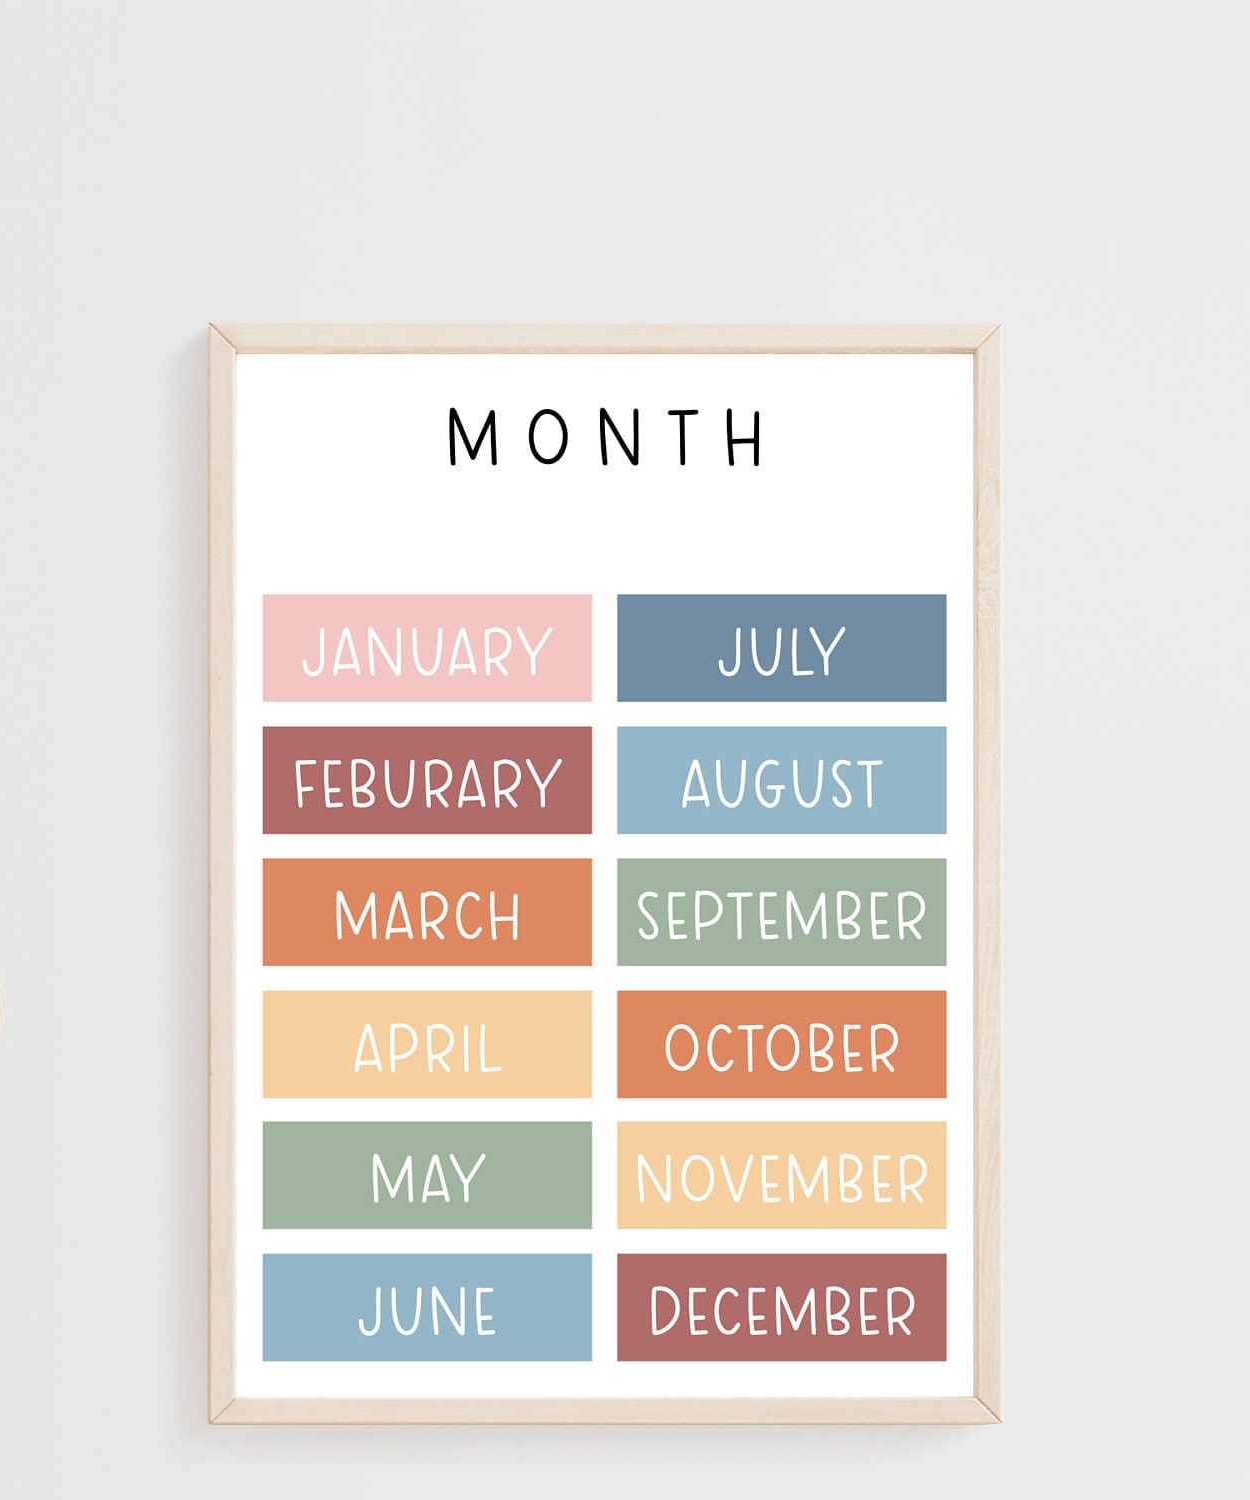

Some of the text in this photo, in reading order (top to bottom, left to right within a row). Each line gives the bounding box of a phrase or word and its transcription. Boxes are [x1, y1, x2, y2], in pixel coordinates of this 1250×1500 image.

[448, 407, 760, 467] MONTH
[302, 626, 554, 677] JANUARY
[718, 626, 846, 677] JULY
[295, 758, 563, 809] FEBURARY
[681, 759, 884, 809] AUGUST
[335, 890, 519, 941] MARCH
[637, 890, 926, 941] SEPTEMBER
[354, 1022, 503, 1074] APRIL
[665, 1022, 899, 1073] OCTOBER
[372, 1153, 486, 1204] MAY
[637, 1153, 928, 1204] NOVEMBER
[358, 1285, 496, 1337] JUNE
[651, 1285, 915, 1336] DECEMBER
